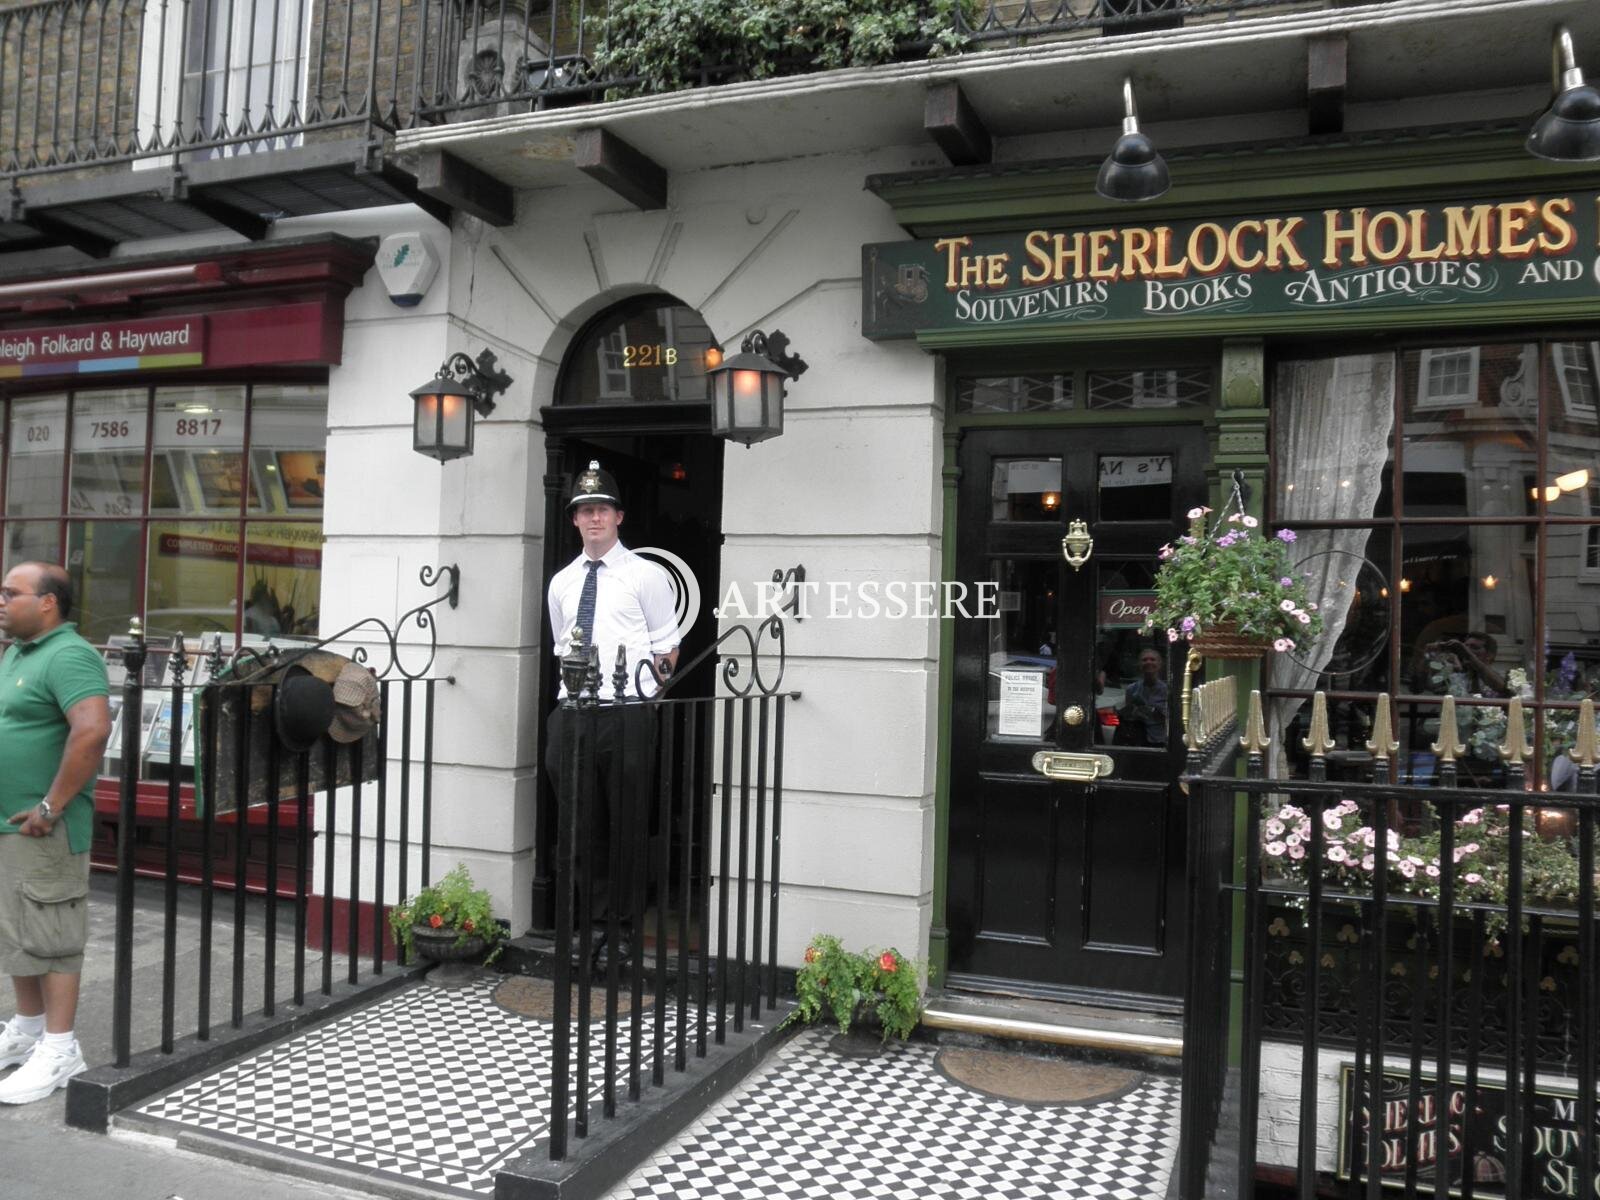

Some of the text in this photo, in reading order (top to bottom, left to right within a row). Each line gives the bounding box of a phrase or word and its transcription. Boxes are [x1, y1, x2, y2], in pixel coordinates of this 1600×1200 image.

[935, 236, 1012, 291] THE
[1021, 216, 1308, 285] SHERLOCK
[1321, 197, 1577, 270] HOLMES
[955, 279, 1109, 323] SOUVENIRS
[1143, 273, 1253, 312] BOOKS
[1284, 259, 1483, 303] ANTIQUES
[1518, 259, 1584, 285] AND
[0, 323, 190, 362] leigh Folkard & Hayward
[623, 344, 678, 368] 221B
[27, 418, 222, 443] 020 7586 8817
[1109, 598, 1151, 618] Open
